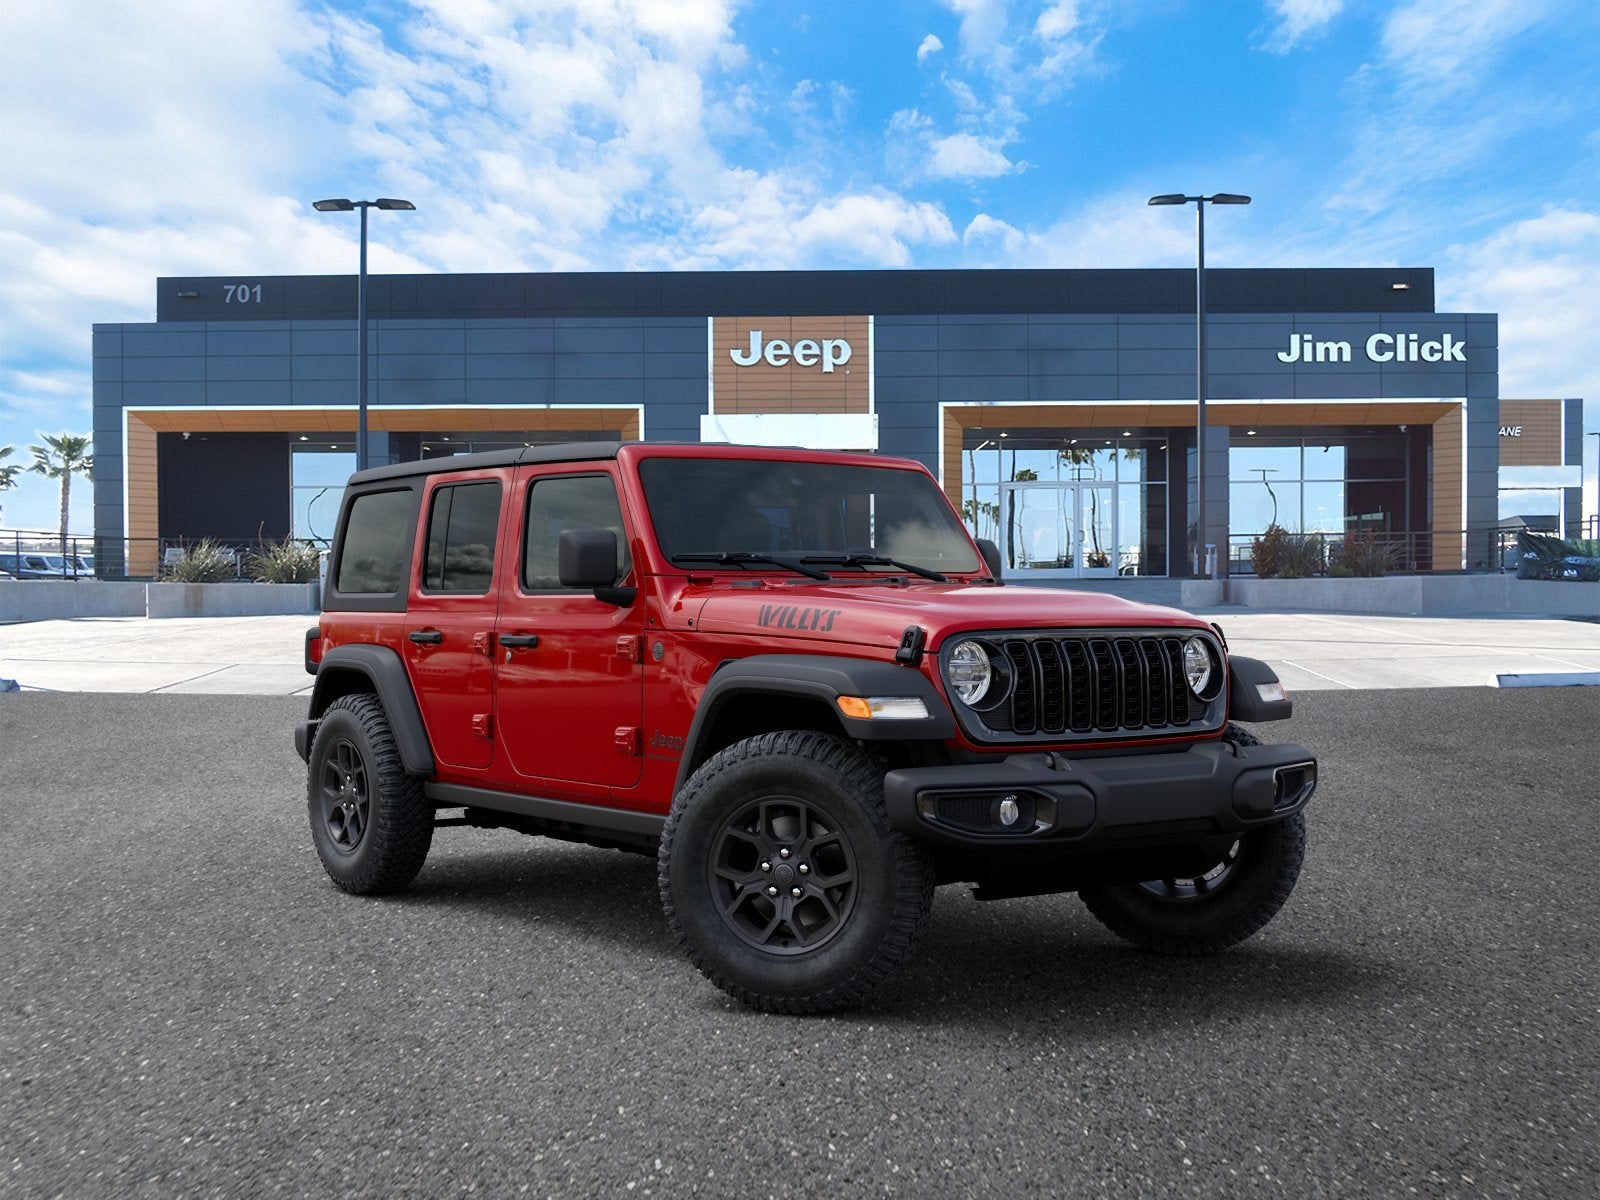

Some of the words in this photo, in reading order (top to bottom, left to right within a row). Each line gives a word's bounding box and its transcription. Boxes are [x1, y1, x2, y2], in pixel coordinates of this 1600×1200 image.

[223, 284, 263, 304] 701
[730, 330, 852, 373] Jeep
[1277, 333, 1352, 363] Jim
[1366, 333, 1467, 363] Click
[757, 604, 842, 632] WILLYS
[649, 729, 684, 752] Jeep
